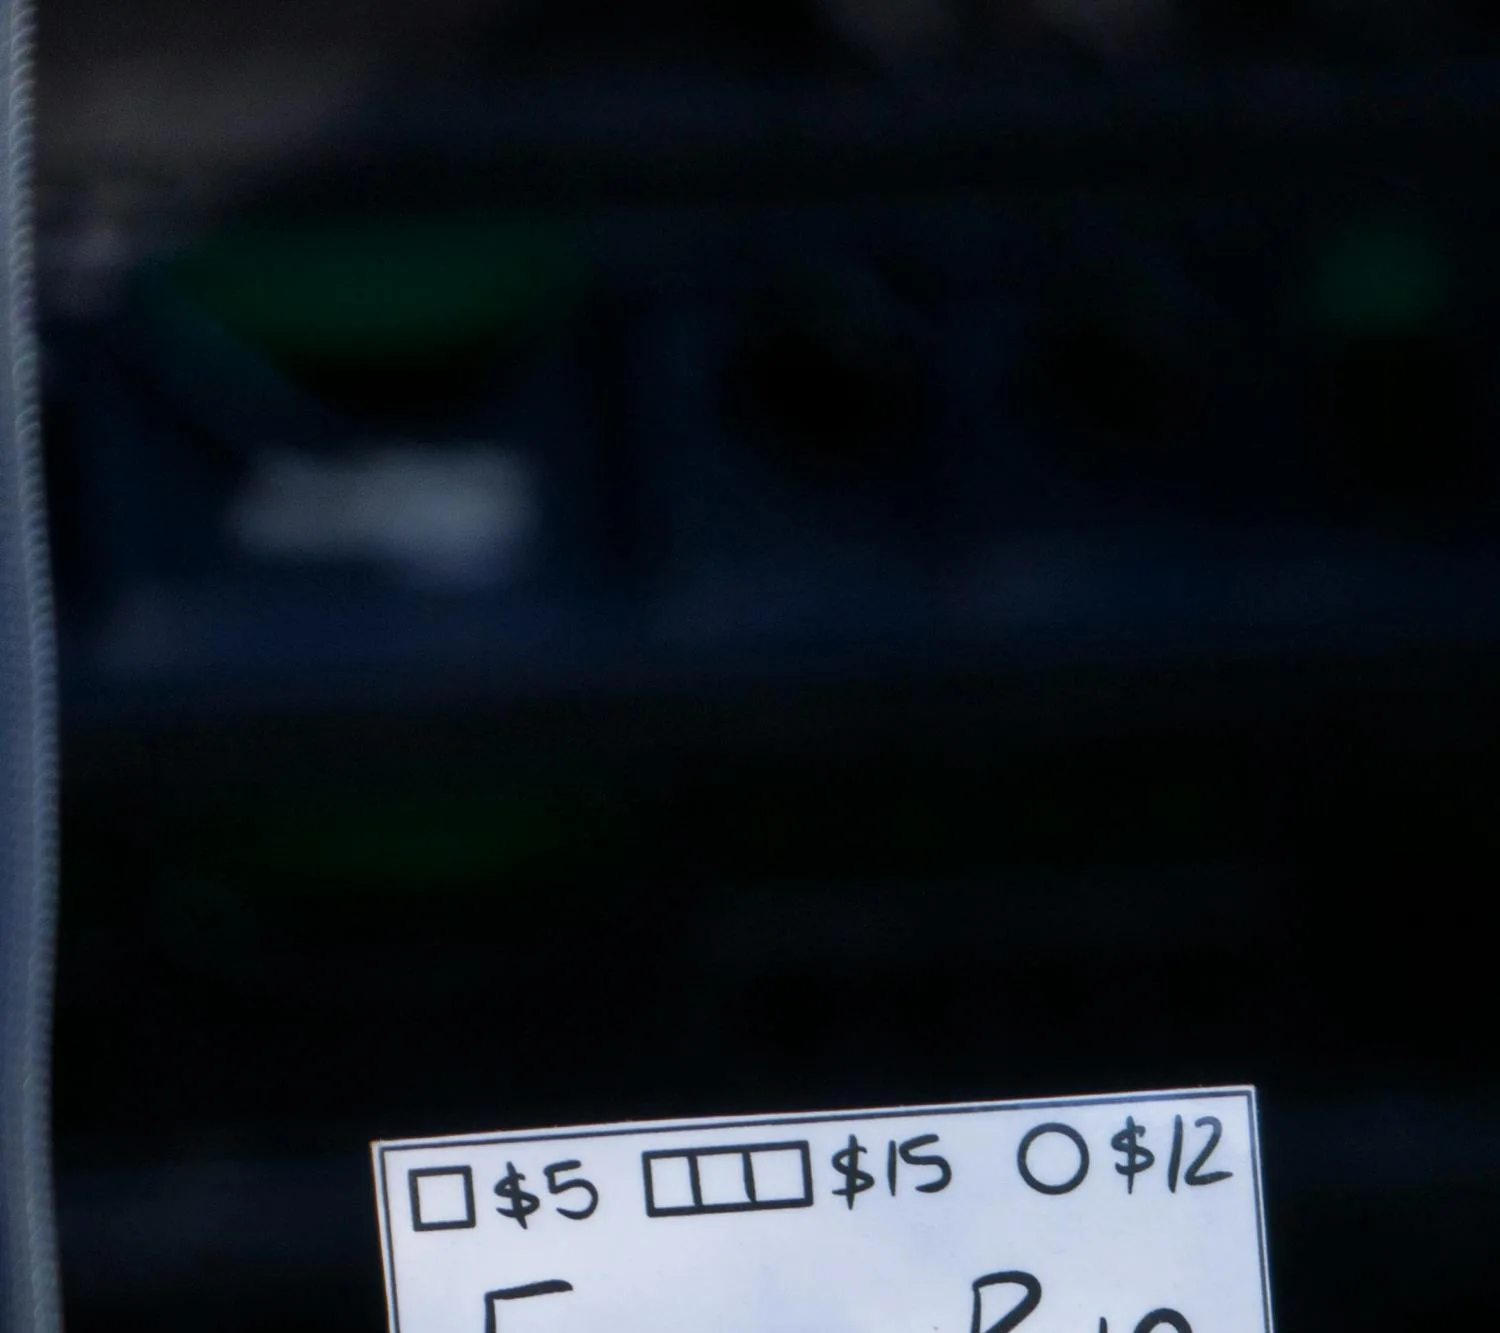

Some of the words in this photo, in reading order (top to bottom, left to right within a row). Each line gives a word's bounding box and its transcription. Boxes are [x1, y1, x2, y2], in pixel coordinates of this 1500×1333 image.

[494, 1160, 600, 1229] $5
[830, 1132, 953, 1209] $15
[1110, 1114, 1234, 1193] $12
